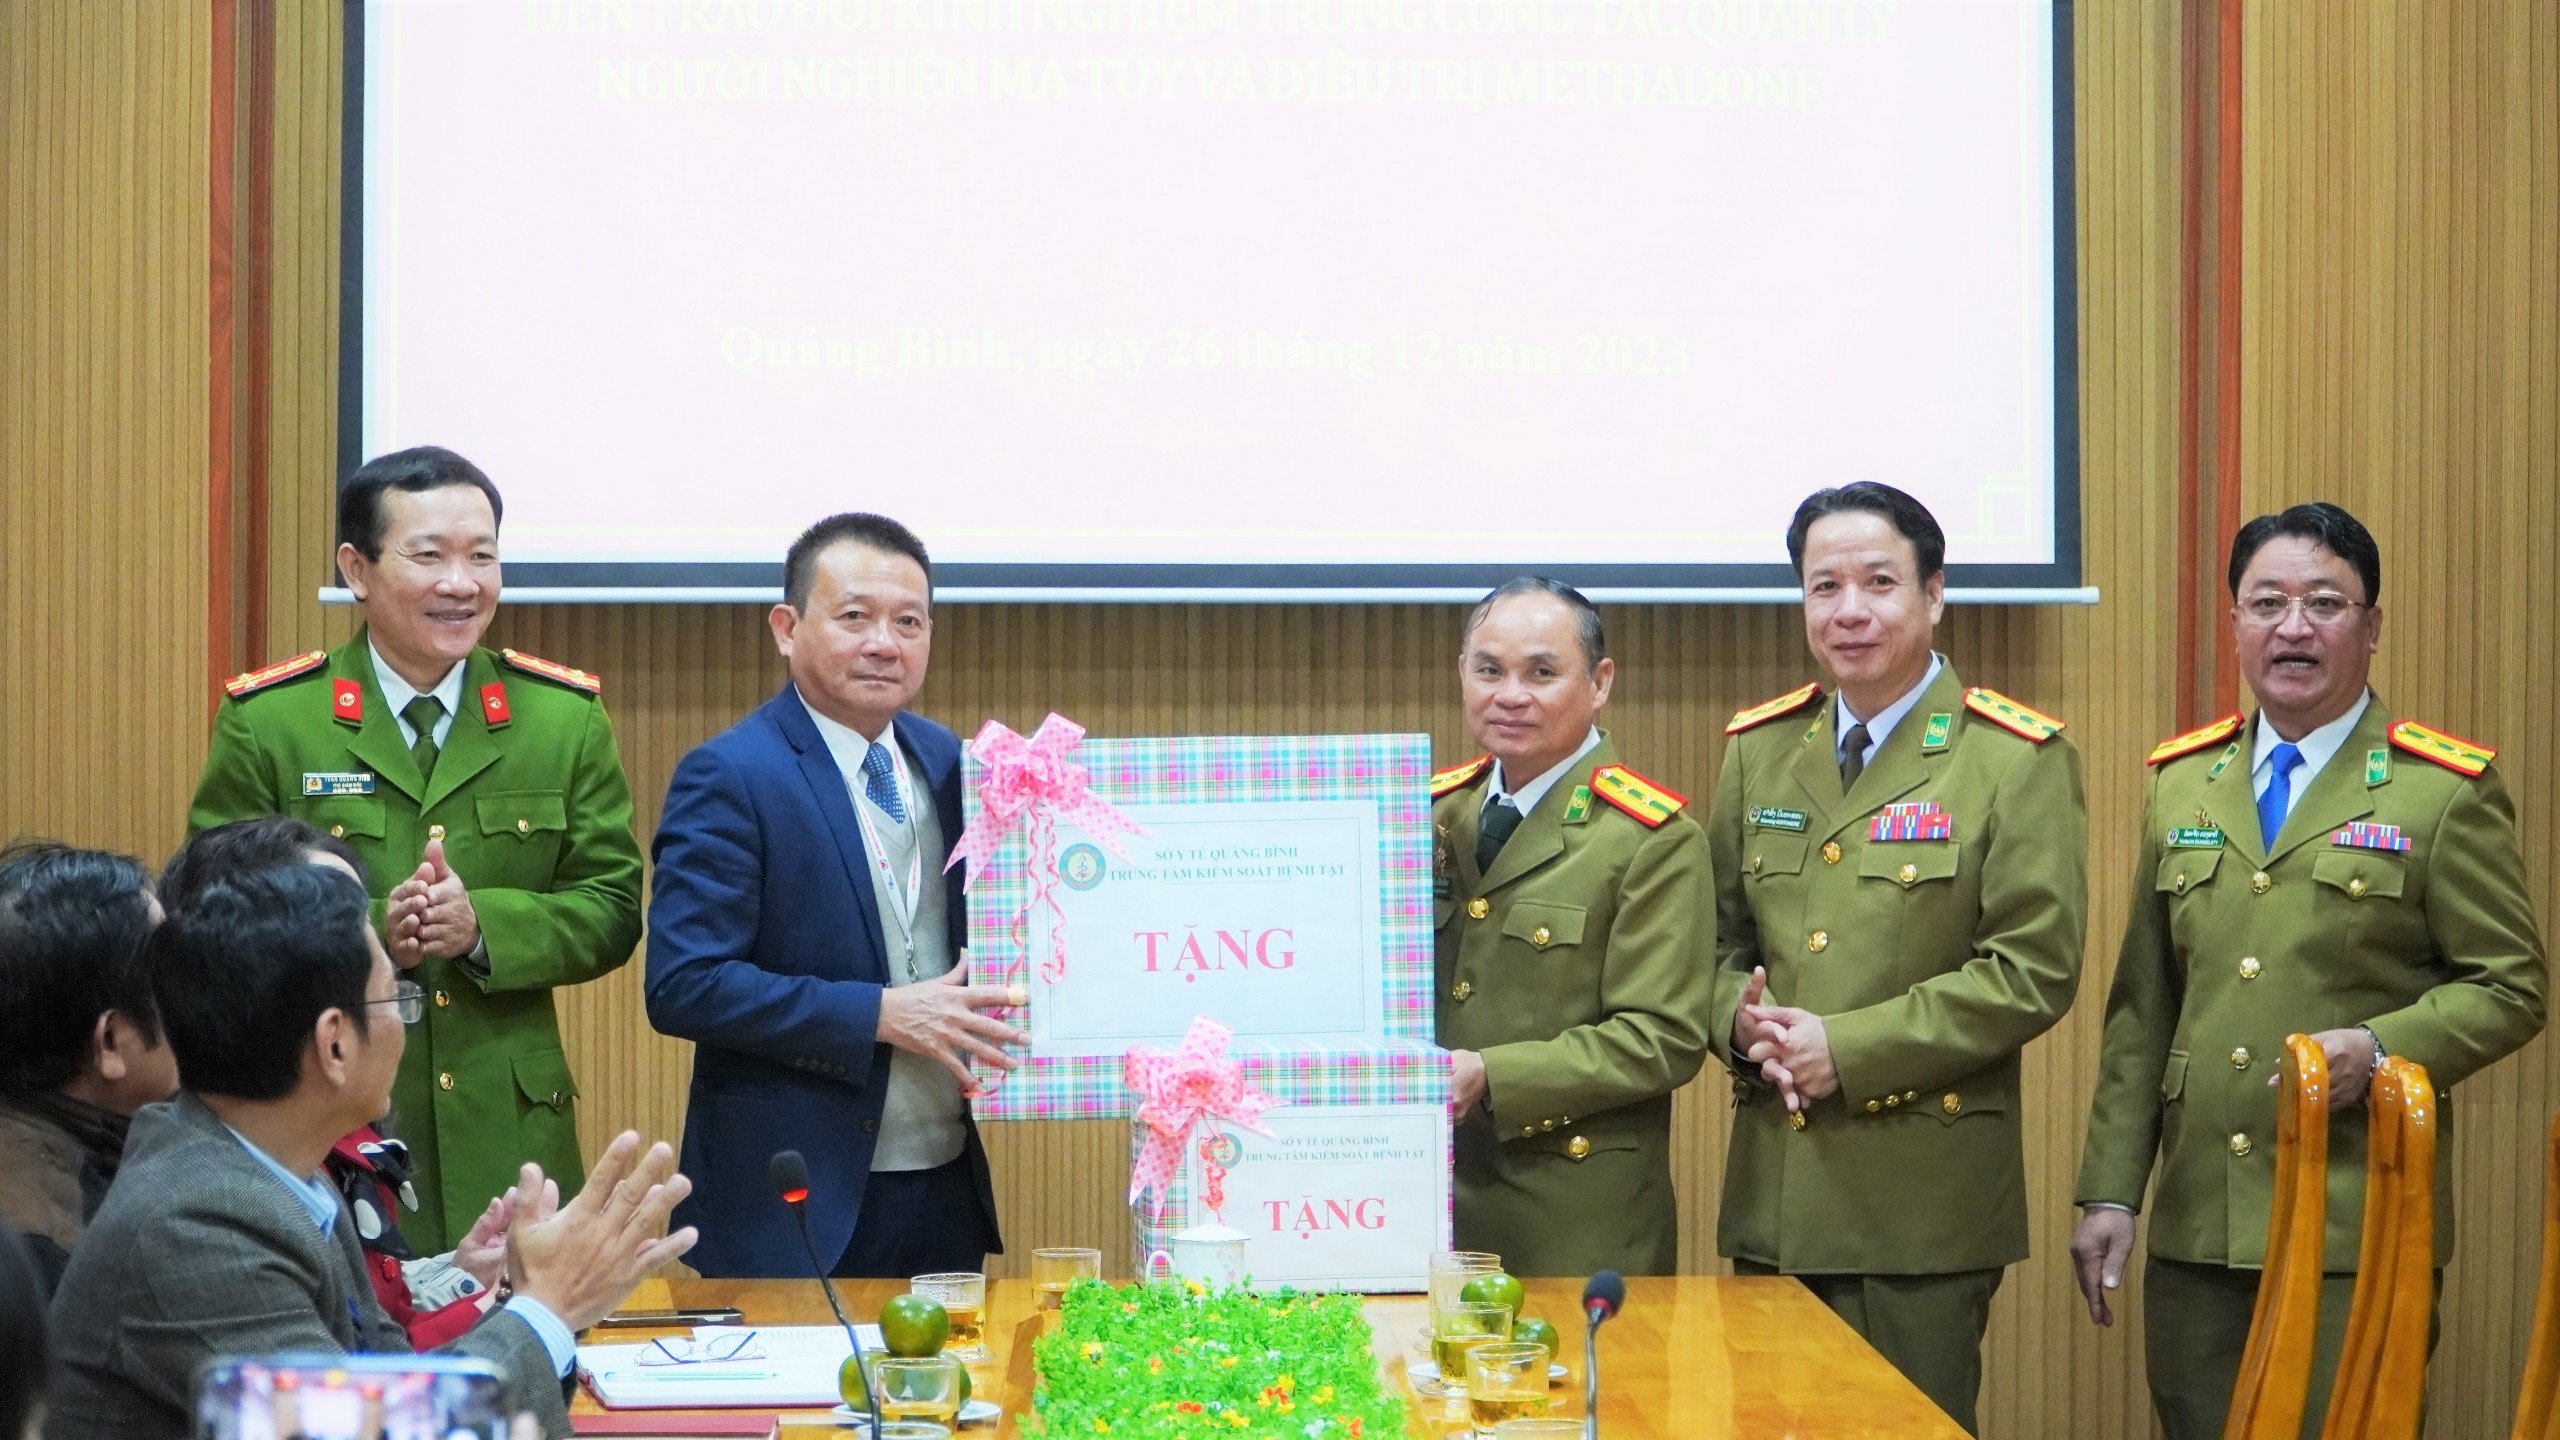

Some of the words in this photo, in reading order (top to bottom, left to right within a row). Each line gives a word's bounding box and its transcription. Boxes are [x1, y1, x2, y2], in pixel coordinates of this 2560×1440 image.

[595, 48, 771, 102] NGƯỜI
[780, 47, 981, 109] NGHIỆN
[988, 56, 1071, 102] MA
[1193, 48, 1259, 102] VÀ
[1393, 57, 1487, 112] TRỊ
[1494, 58, 1829, 112] METHADONE
[719, 325, 889, 379] Quảng
[1037, 327, 1152, 381] ngày
[1162, 328, 1224, 369] 26
[1236, 327, 1375, 383] tháng
[1390, 329, 1444, 372] 12
[1456, 332, 1564, 374] năm
[1574, 331, 1695, 376] 2023
[1176, 850, 1186, 860] Y
[1210, 847, 1261, 861] QUẢNG
[1265, 846, 1299, 858] BÌNH
[1109, 869, 1158, 881] TRUNG
[1160, 865, 1195, 880] TÂM
[1237, 864, 1276, 878] SOÁT
[1134, 923, 1298, 983] TẶNG
[1296, 1137, 1304, 1146] Y
[1321, 1135, 1361, 1147] QUẢNG
[1245, 1153, 1282, 1162] TRUNG
[1263, 1194, 1387, 1240] TẶNG
